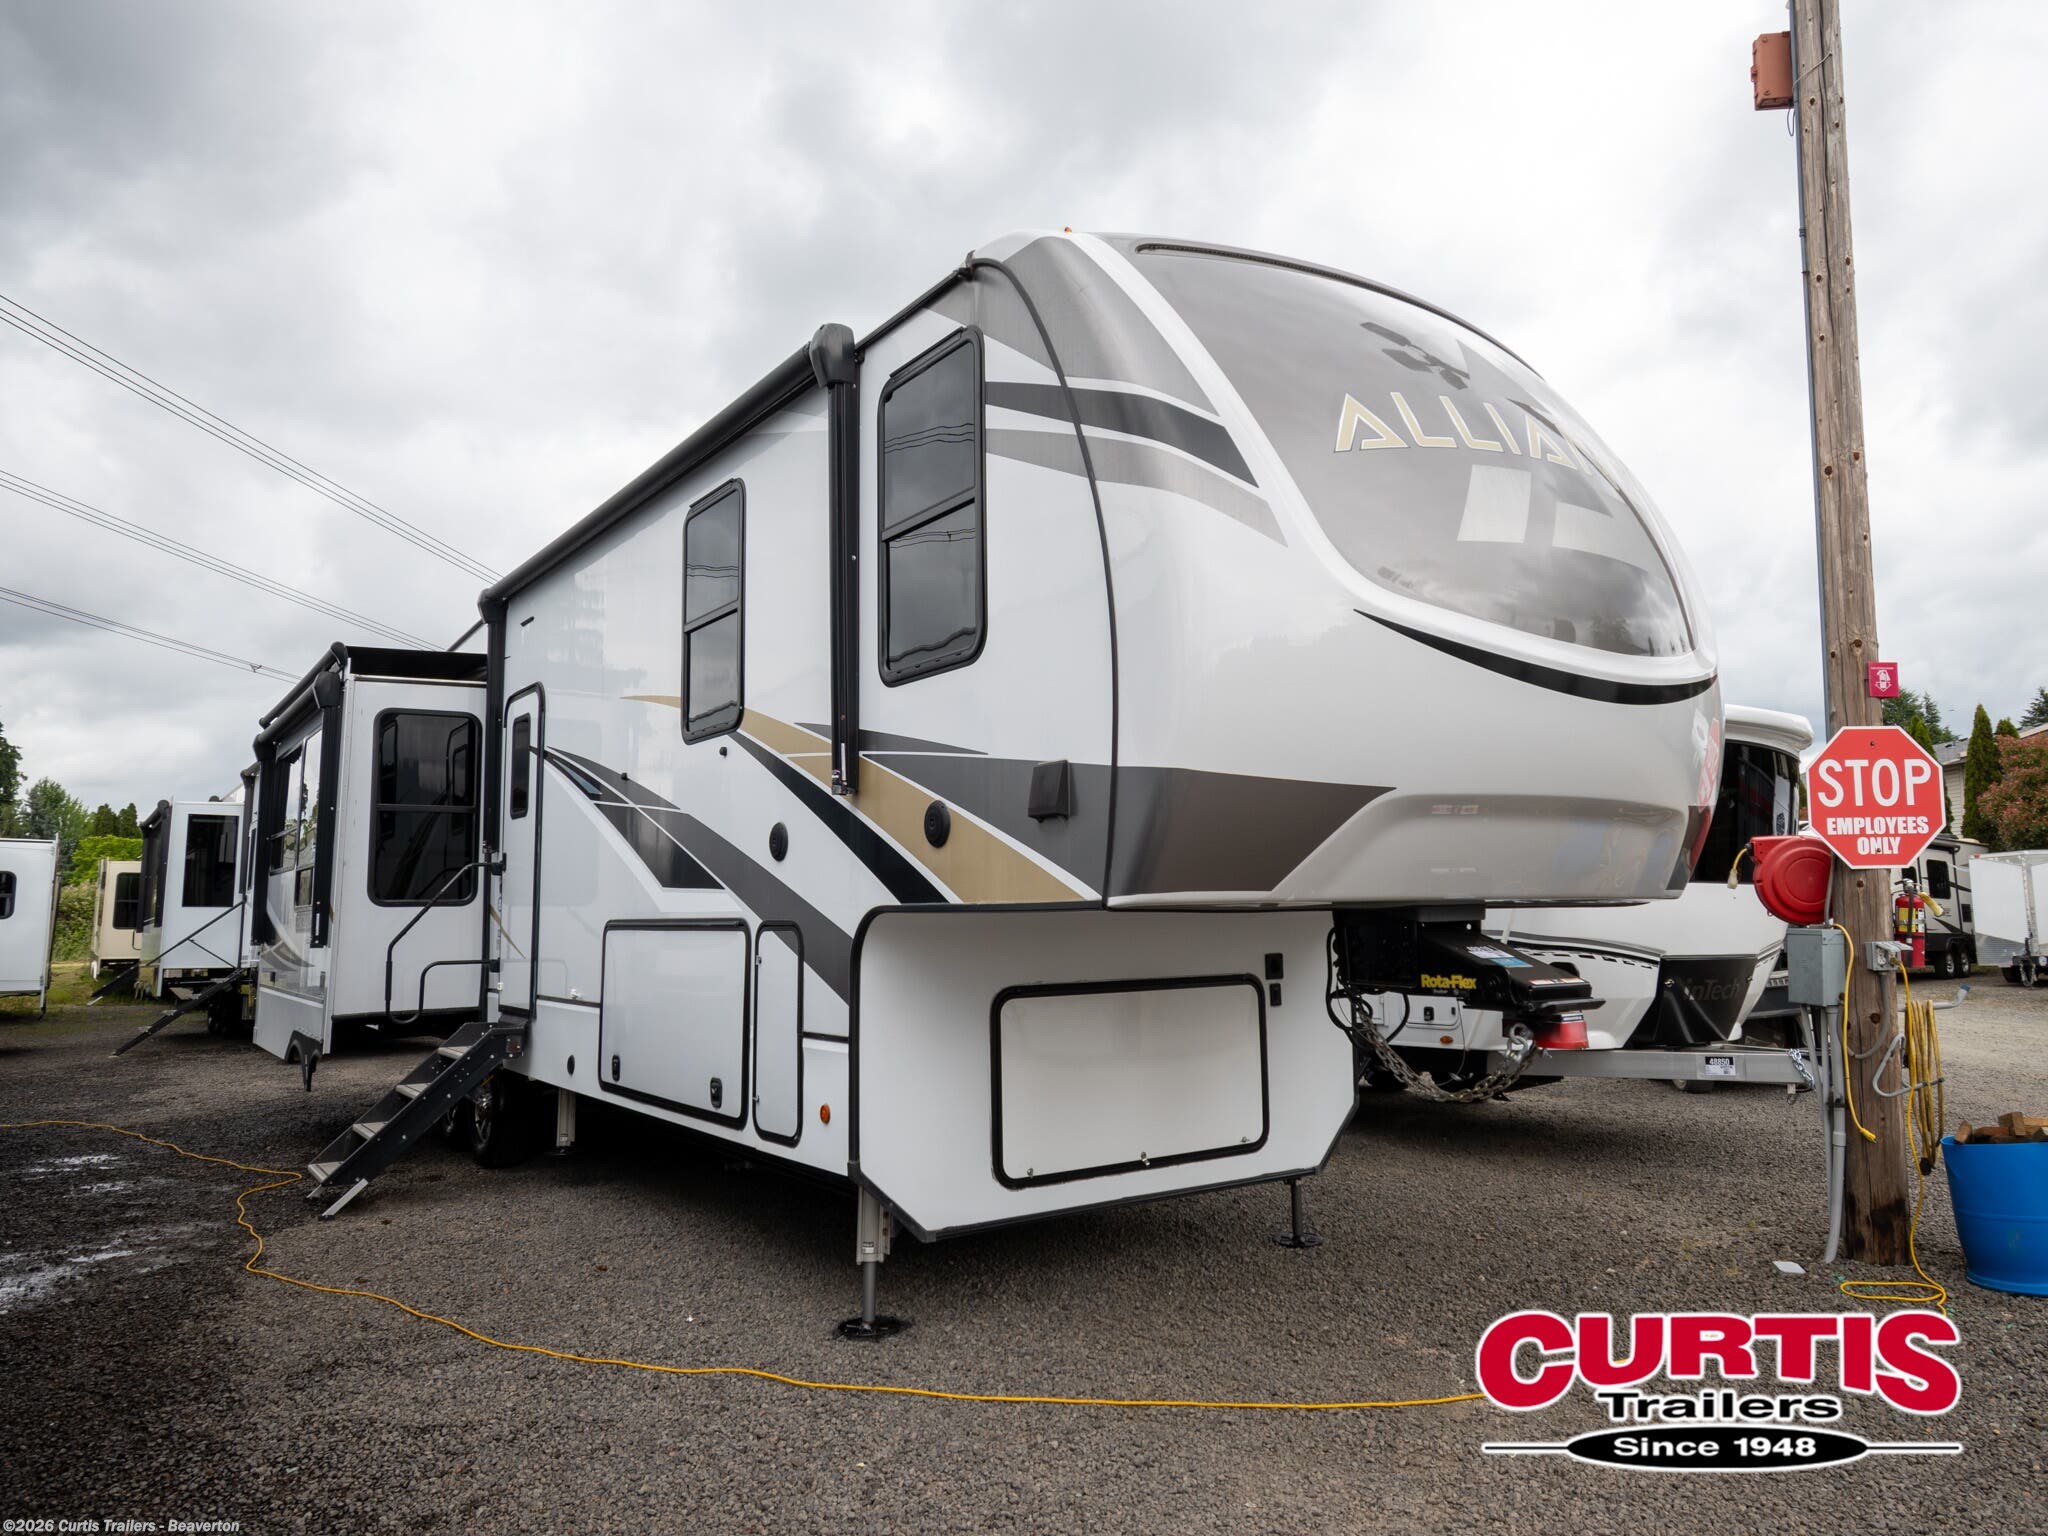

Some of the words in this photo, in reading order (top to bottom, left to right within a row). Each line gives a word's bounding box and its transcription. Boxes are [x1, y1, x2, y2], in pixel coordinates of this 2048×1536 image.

[1817, 758, 1931, 808] STOP
[1826, 815, 1930, 835] EMPLOYEES
[1857, 836, 1901, 855] ONLY
